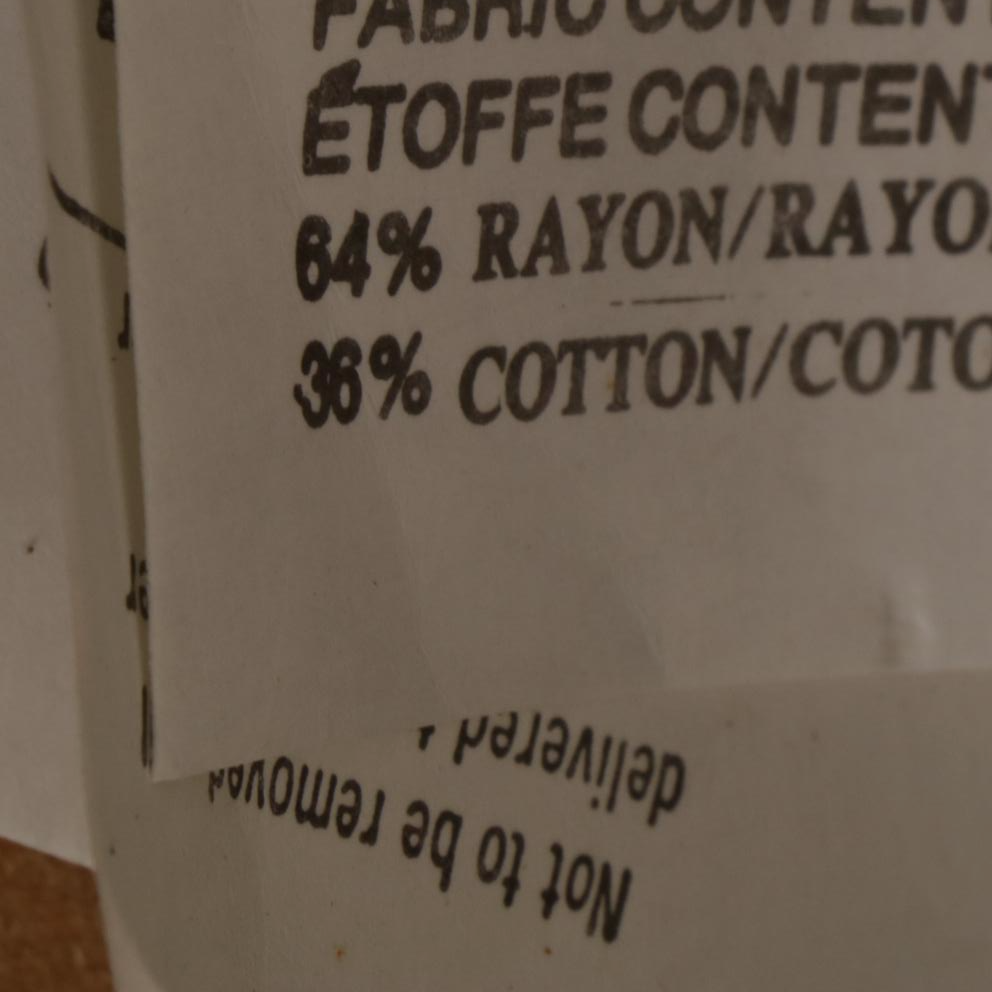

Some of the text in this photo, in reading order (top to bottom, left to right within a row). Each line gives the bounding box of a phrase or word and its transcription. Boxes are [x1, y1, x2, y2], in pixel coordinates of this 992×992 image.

[302, 59, 612, 176] ÉTOFFE
[295, 206, 442, 303] 64%
[293, 331, 432, 429] 36%
[401, 800, 463, 892] be
[477, 826, 525, 908] to
[541, 843, 632, 944] Not
